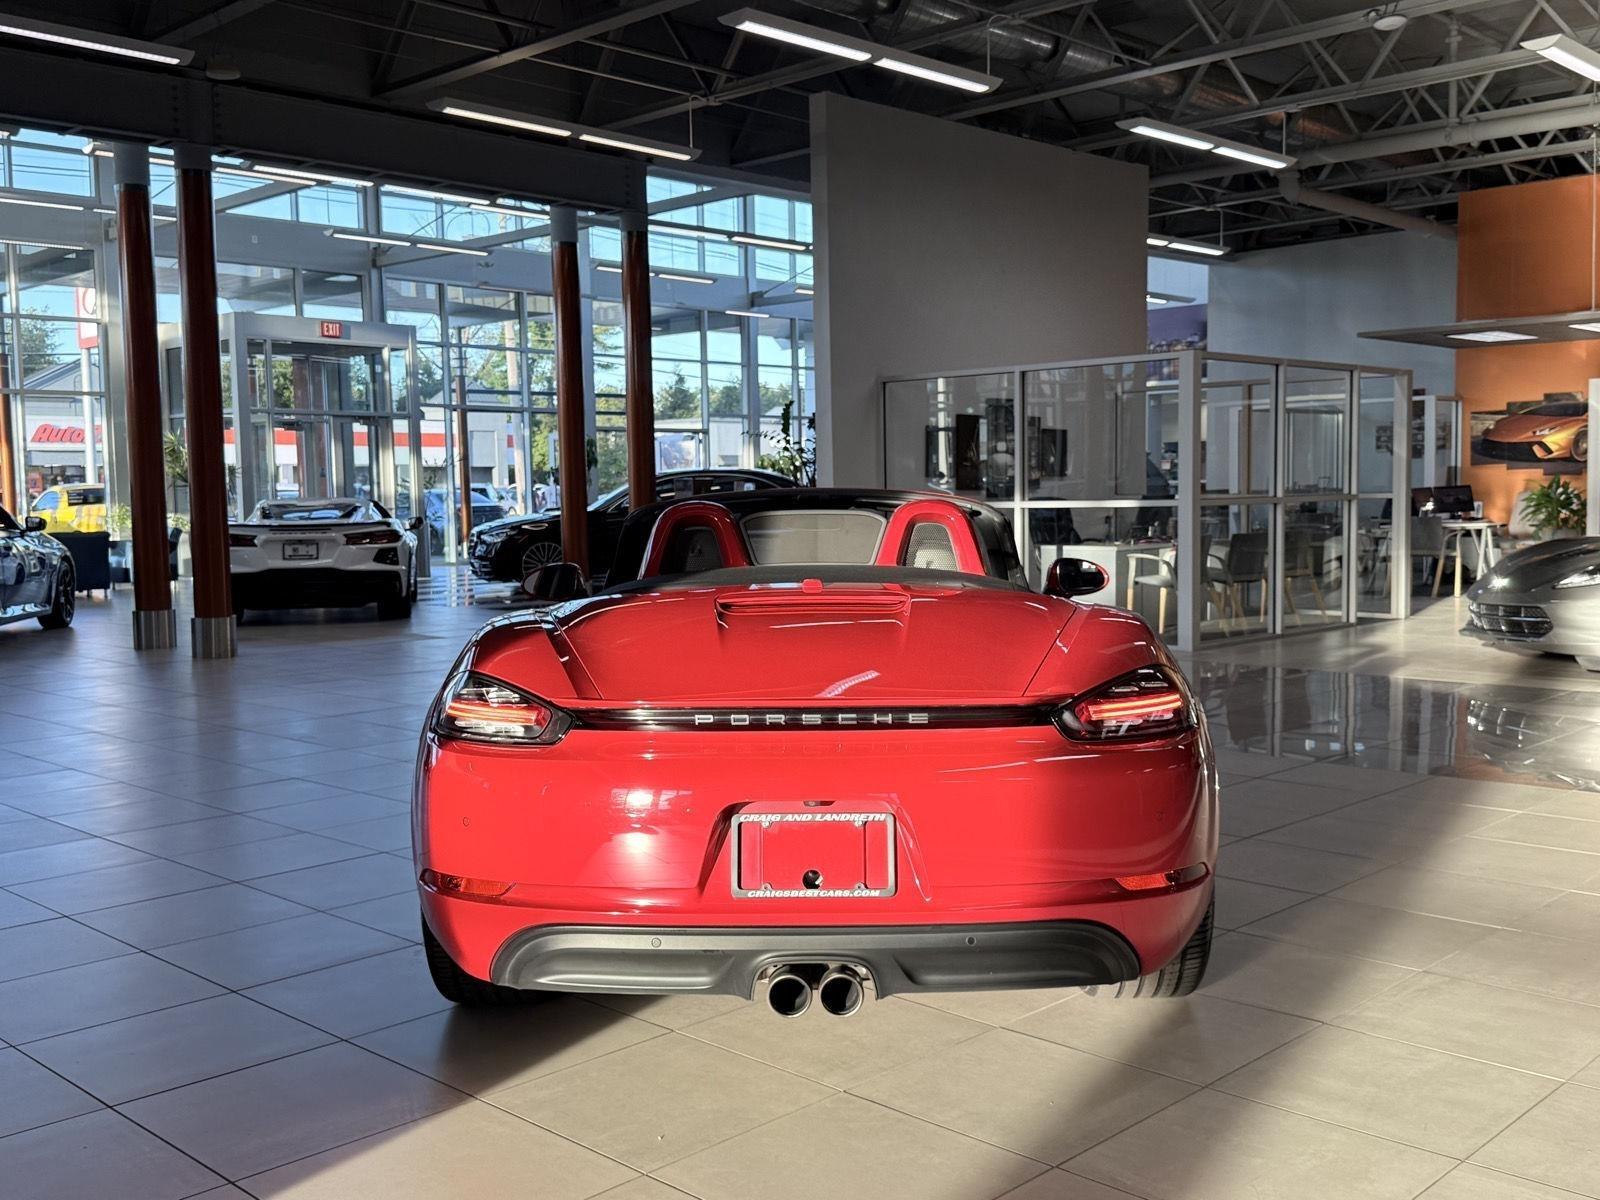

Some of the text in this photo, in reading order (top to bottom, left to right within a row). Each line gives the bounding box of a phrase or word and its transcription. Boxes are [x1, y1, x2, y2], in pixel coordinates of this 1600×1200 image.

[323, 322, 341, 337] EXIT
[694, 713, 930, 726] PORSCHE
[739, 813, 887, 822] CRAIG AND LANDRETH
[747, 889, 881, 898] CRAIGSBESTCARS.COM
